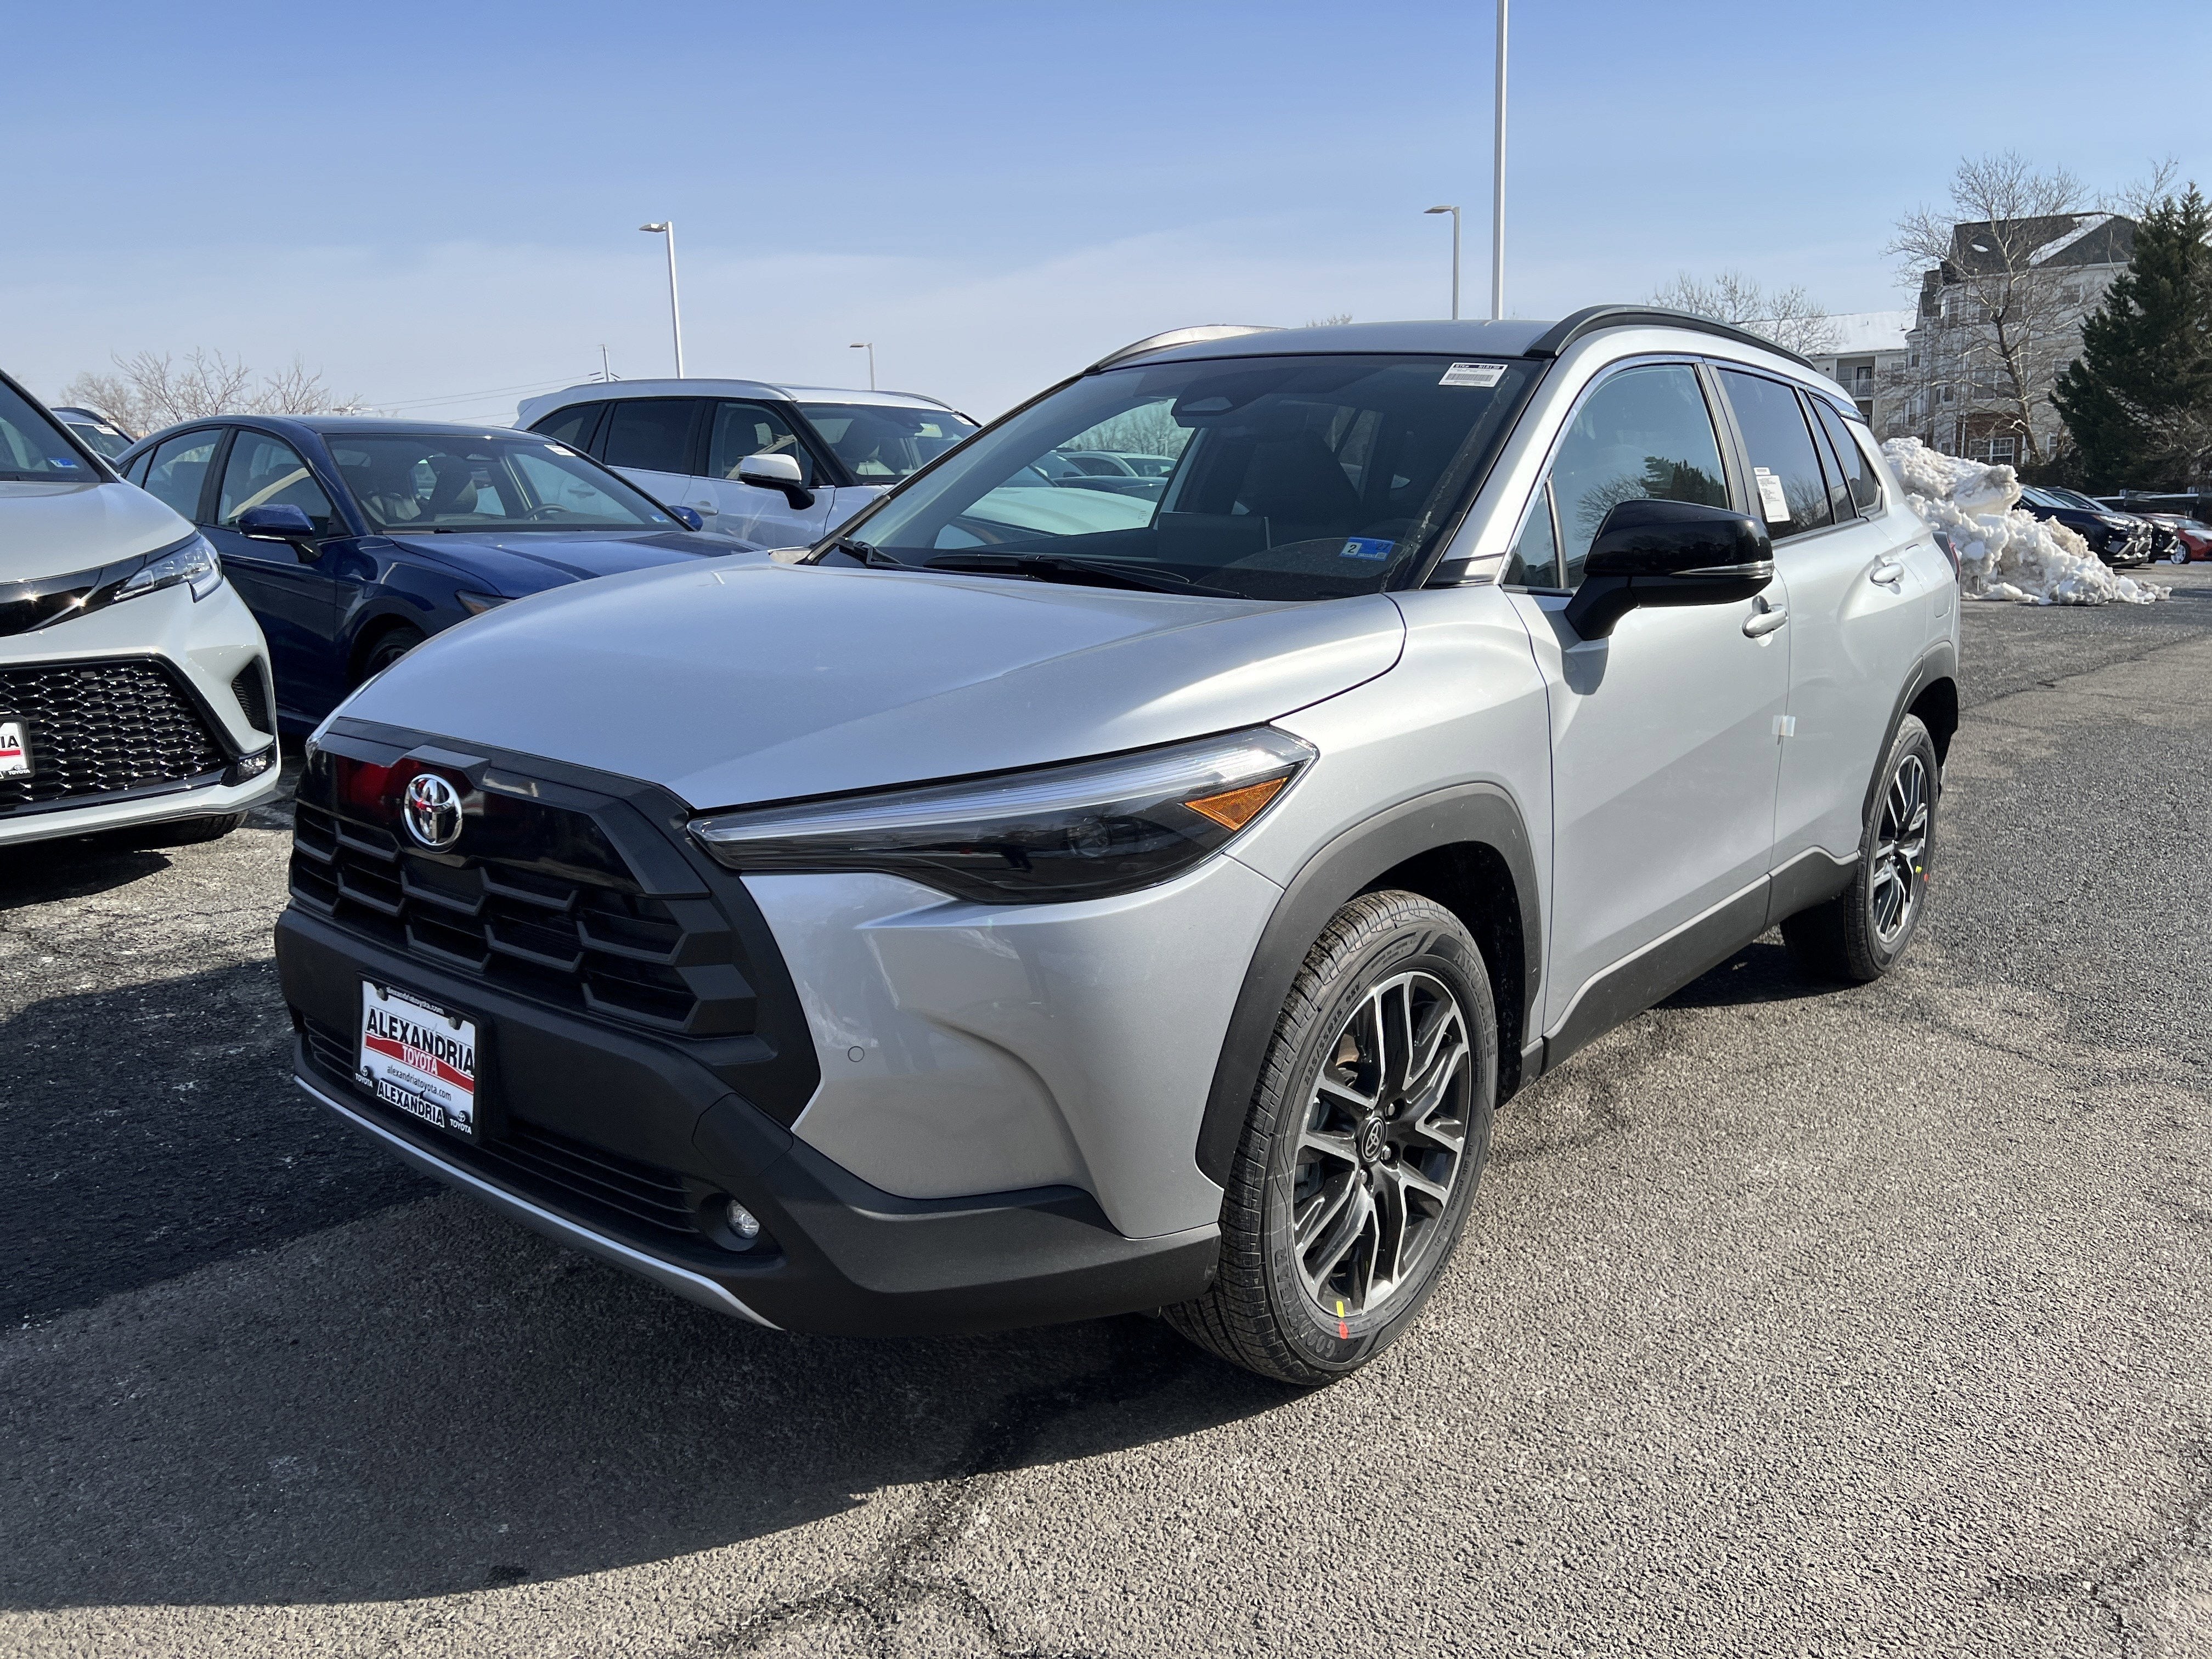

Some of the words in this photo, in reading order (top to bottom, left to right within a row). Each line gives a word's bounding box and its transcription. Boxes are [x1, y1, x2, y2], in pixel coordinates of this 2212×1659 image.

[1347, 544, 1357, 553] 2
[366, 1008, 475, 1075] ALEXANDRIA
[402, 1045, 438, 1076] TOYOTA
[356, 1073, 373, 1088] TOYOTA
[387, 1064, 452, 1101] alexandriatoyota.com
[376, 1080, 445, 1128] ALEXANDRIA
[449, 1118, 472, 1135] TOYOTA
